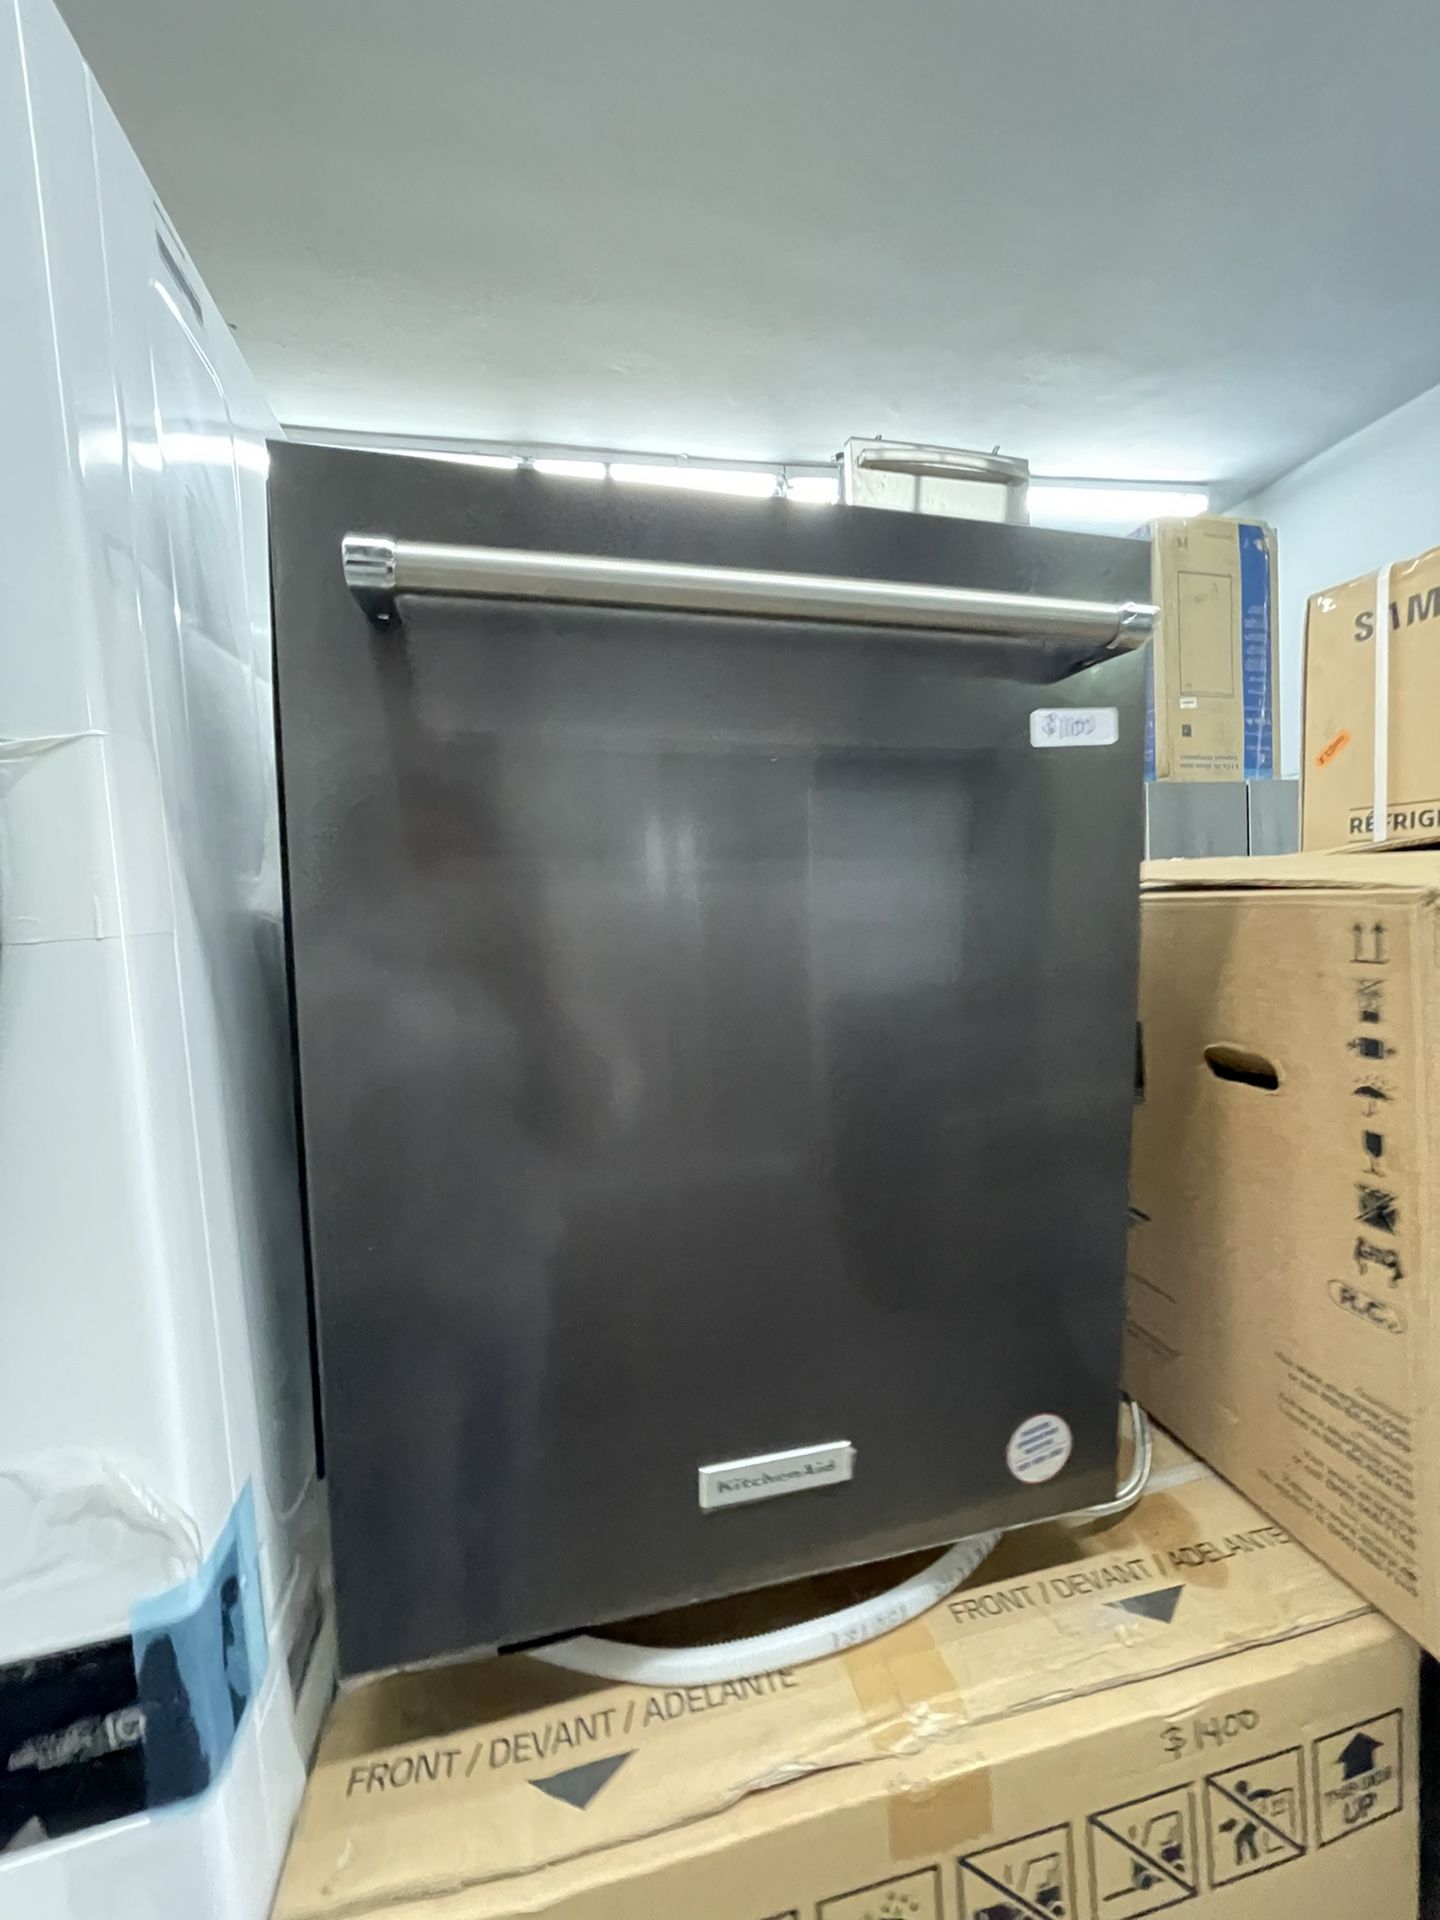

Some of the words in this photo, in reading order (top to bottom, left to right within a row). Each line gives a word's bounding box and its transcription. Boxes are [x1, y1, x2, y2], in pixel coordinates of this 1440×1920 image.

[948, 1585, 1036, 1623] FRONT
[1051, 1558, 1152, 1598] DEVANT
[1168, 1526, 1291, 1571] ADELANTE
[346, 1750, 461, 1797] FRONT
[489, 1708, 616, 1769] DEVANT
[643, 1669, 798, 1727] ADELANTE
[1159, 1709, 1260, 1760] $1400
[1344, 1791, 1377, 1824] UP
